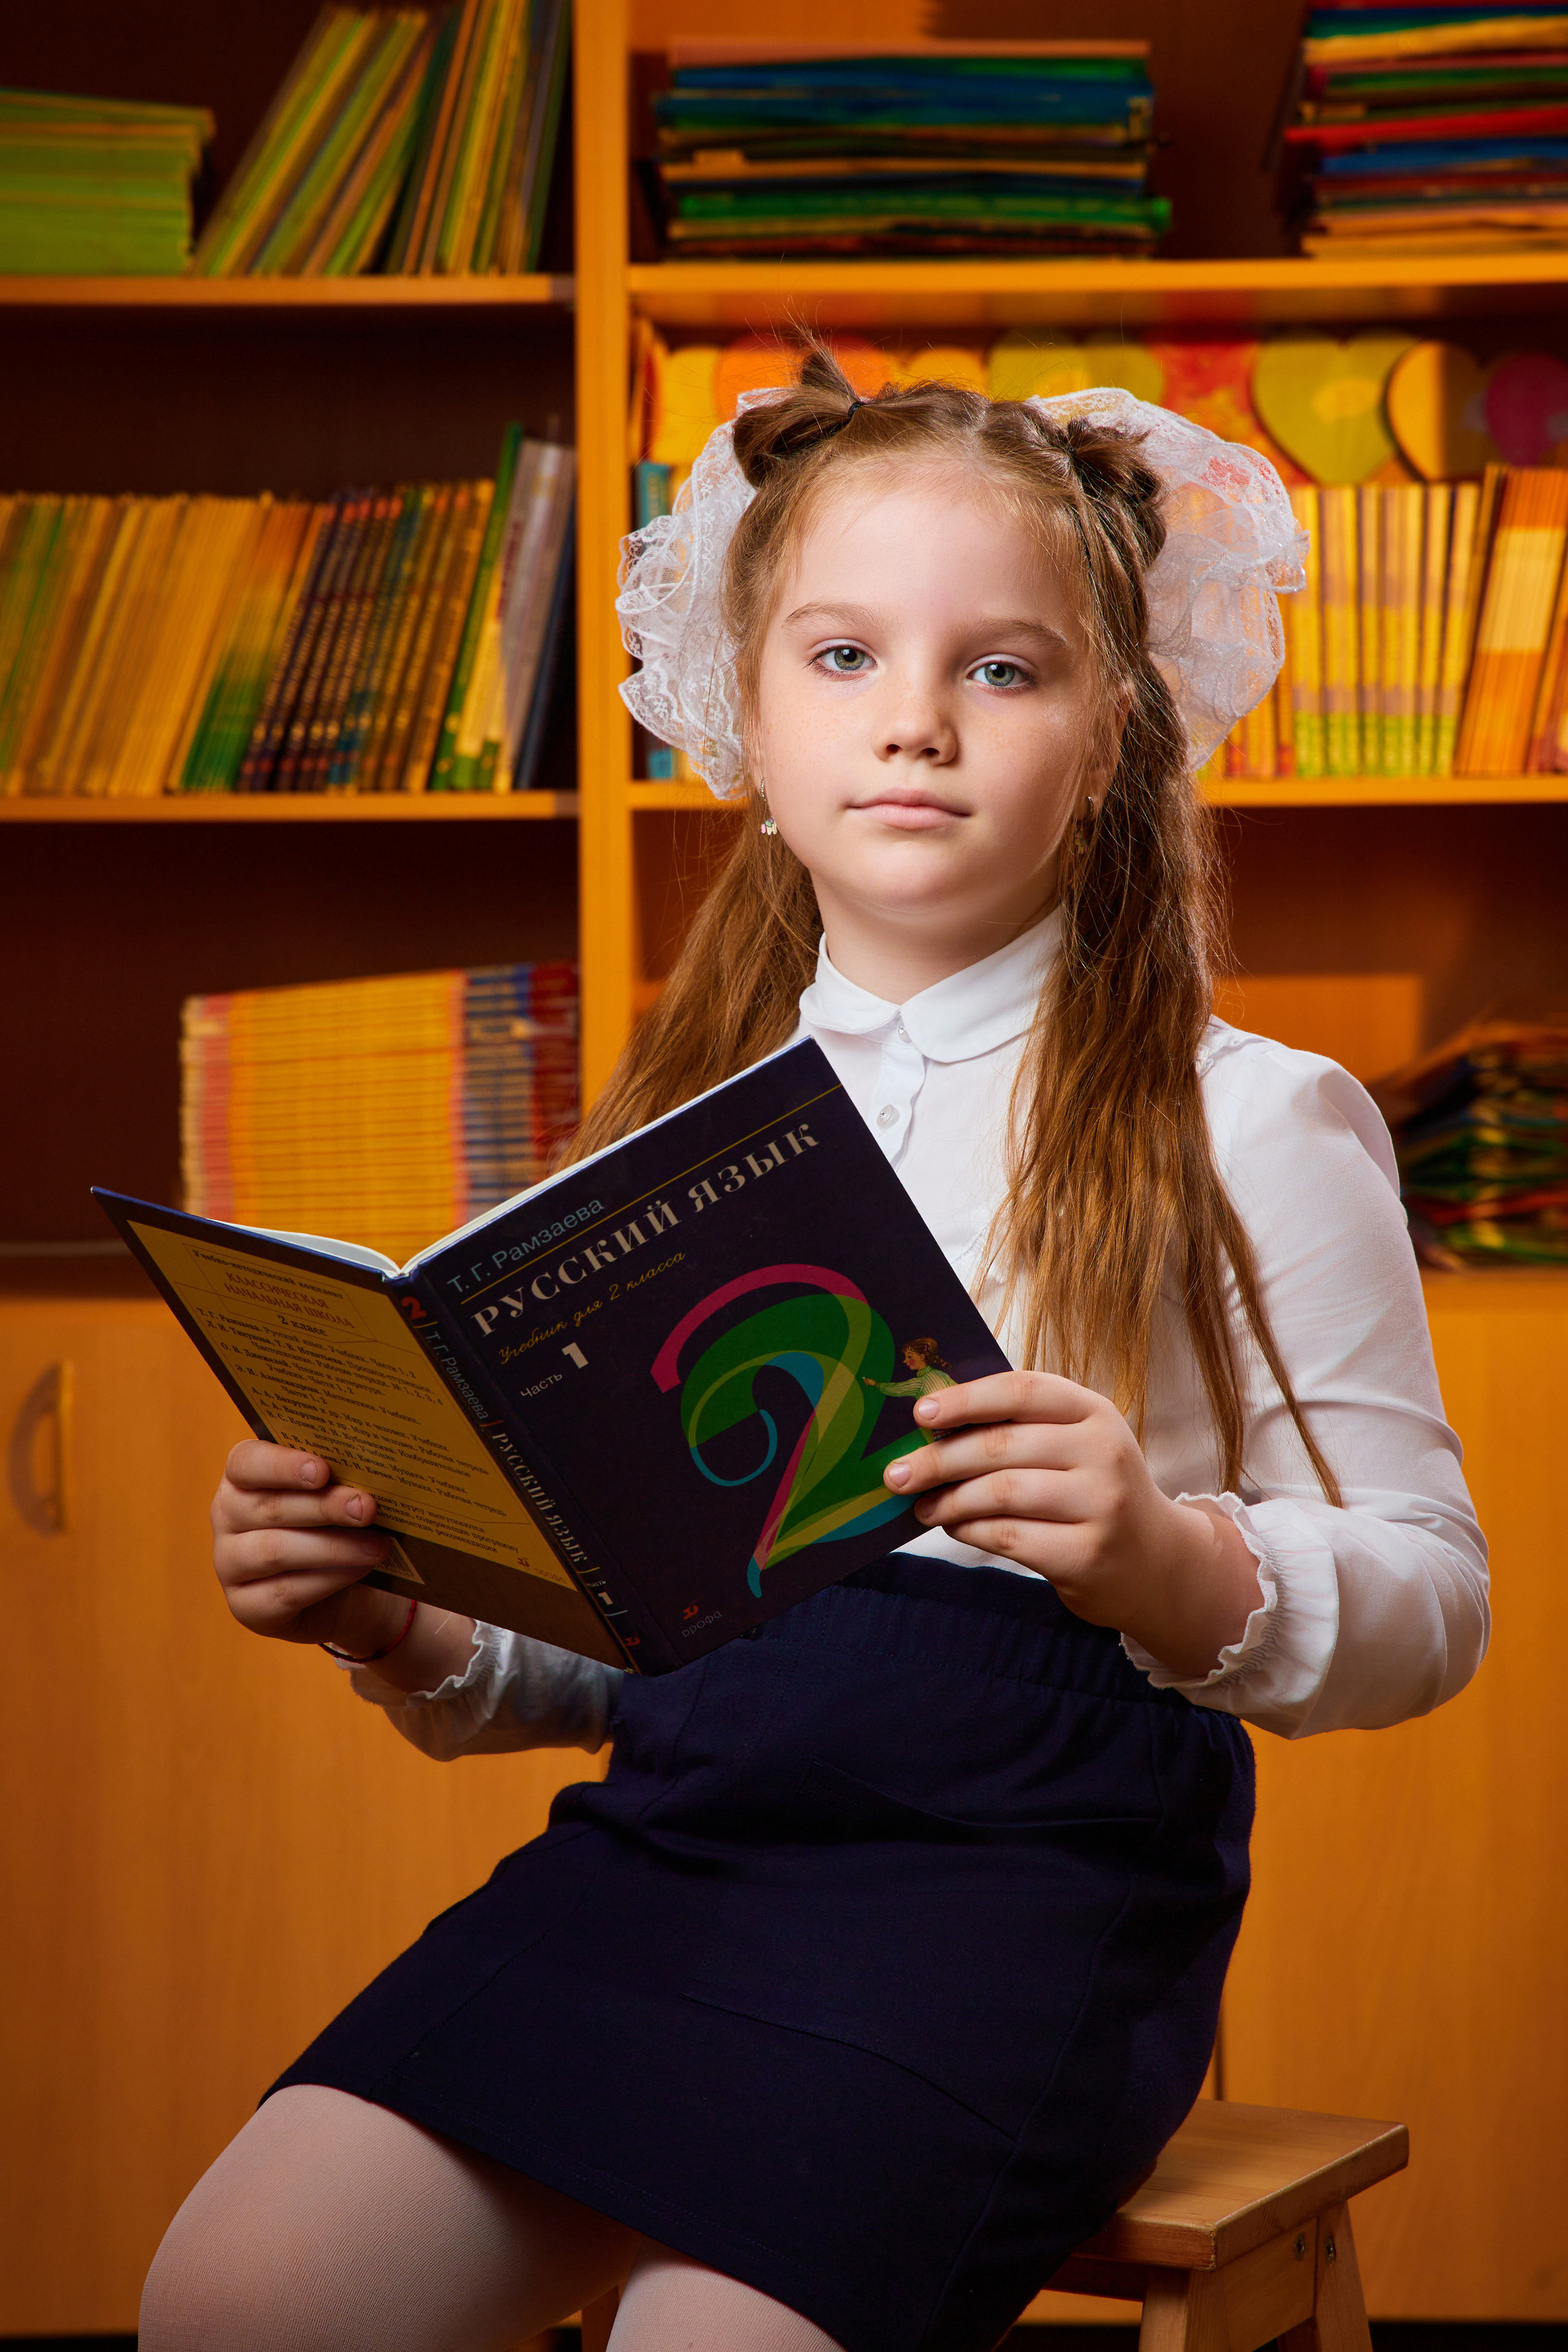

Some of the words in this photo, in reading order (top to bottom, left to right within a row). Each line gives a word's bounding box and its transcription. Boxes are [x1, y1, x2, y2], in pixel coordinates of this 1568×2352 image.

[447, 1275, 470, 1293] Т.
[470, 1262, 491, 1282] Г.
[491, 1199, 605, 1270] Рамзаева
[470, 1200, 682, 1337] РУССКИЙ
[687, 1123, 820, 1213] ЯЗЫК
[191, 1249, 297, 1286] Учебно-методический
[297, 1281, 344, 1300] комплект
[225, 1271, 330, 1310] КЛАССИЧЕСКАЯ
[222, 1283, 304, 1314] НАЧАЛЬНАЯ
[303, 1305, 356, 1329] ШКОЛА
[277, 1314, 290, 1326] 2
[289, 1320, 328, 1337] класс
[401, 1296, 428, 1321] 2
[498, 1321, 568, 1365] Учебник
[573, 1300, 603, 1327] для
[609, 1283, 620, 1301] 2
[627, 1252, 686, 1292] класса
[195, 1306, 209, 1317] Т.
[207, 1310, 219, 1320] Г.
[217, 1313, 263, 1333] Рамзаева.
[262, 1325, 301, 1343] Русский
[301, 1339, 328, 1351] язык.
[326, 1344, 370, 1364] Учебник.
[368, 1357, 398, 1373] Части
[408, 1370, 417, 1379] 2
[228, 1326, 276, 1347] Тикунова,
[273, 1339, 286, 1349] Т.
[285, 1342, 298, 1352] В.
[296, 1346, 347, 1366] Игнатьева.
[426, 1331, 441, 1343] Т.
[432, 1344, 450, 1355] Г.
[220, 1341, 232, 1351] О.
[230, 1344, 243, 1355] В.
[242, 1348, 292, 1368] Джежелей.
[290, 1362, 325, 1378] Чтение
[334, 1376, 386, 1396] литература.
[250, 1340, 315, 1366] Чистописание.
[315, 1359, 353, 1376] Рабочие
[352, 1372, 391, 1389] тетради.
[265, 1363, 308, 1381] Учебник.
[306, 1375, 336, 1390] Части
[346, 1386, 355, 1395] 2
[440, 1357, 489, 1420] Рамзаева
[519, 1374, 563, 1397] Часть
[561, 1341, 589, 1370] 1
[235, 1363, 247, 1373] Э.
[259, 1371, 323, 1395] Александрова.
[322, 1389, 380, 1412] Математика.
[377, 1406, 421, 1426] Учебник.
[251, 1386, 263, 1396] А.
[263, 1389, 275, 1400] А.
[273, 1392, 319, 1412] Вахрушев
[341, 1412, 363, 1427] Мир
[372, 1423, 410, 1440] человек.
[409, 1433, 450, 1452] Учебник
[280, 1385, 309, 1400] Части
[319, 1396, 328, 1405] 2
[259, 1398, 271, 1408] А.
[271, 1401, 282, 1411] А.
[281, 1404, 327, 1424] Вахрушев
[349, 1424, 371, 1439] Мир
[380, 1435, 418, 1452] человек.
[417, 1446, 456, 1464] Рабочая
[455, 1459, 490, 1476] тетрадь
[287, 1415, 320, 1432] Кузин,
[341, 1432, 398, 1455] Кубышкина.
[396, 1449, 472, 1479] Изобразительное
[312, 1432, 359, 1450] искусство.
[358, 1444, 398, 1463] Учебник
[280, 1431, 292, 1441] В.
[290, 1434, 303, 1444] В.
[304, 1438, 334, 1454] Алеев,
[332, 1446, 345, 1456] Т.
[356, 1453, 389, 1469] Кичак.
[388, 1463, 428, 1482] Музыка.
[427, 1475, 468, 1494] Учебник
[340, 1458, 353, 1468] Т.
[364, 1465, 397, 1482] Кичак.
[396, 1475, 436, 1494] Музыка.
[435, 1487, 473, 1506] Рабочая
[473, 1501, 508, 1517] тетрадь
[399, 1502, 425, 1515] курсу
[426, 1510, 486, 1534] выпускаются
[491, 1432, 556, 1511] РУССКИЙ
[545, 1514, 588, 1563] ЯЗЫК
[415, 1515, 470, 1537] содержащие
[470, 1532, 519, 1554] программу
[434, 1528, 499, 1553] рекомендации
[586, 1580, 606, 1590] Часть
[597, 1591, 614, 1606] 1
